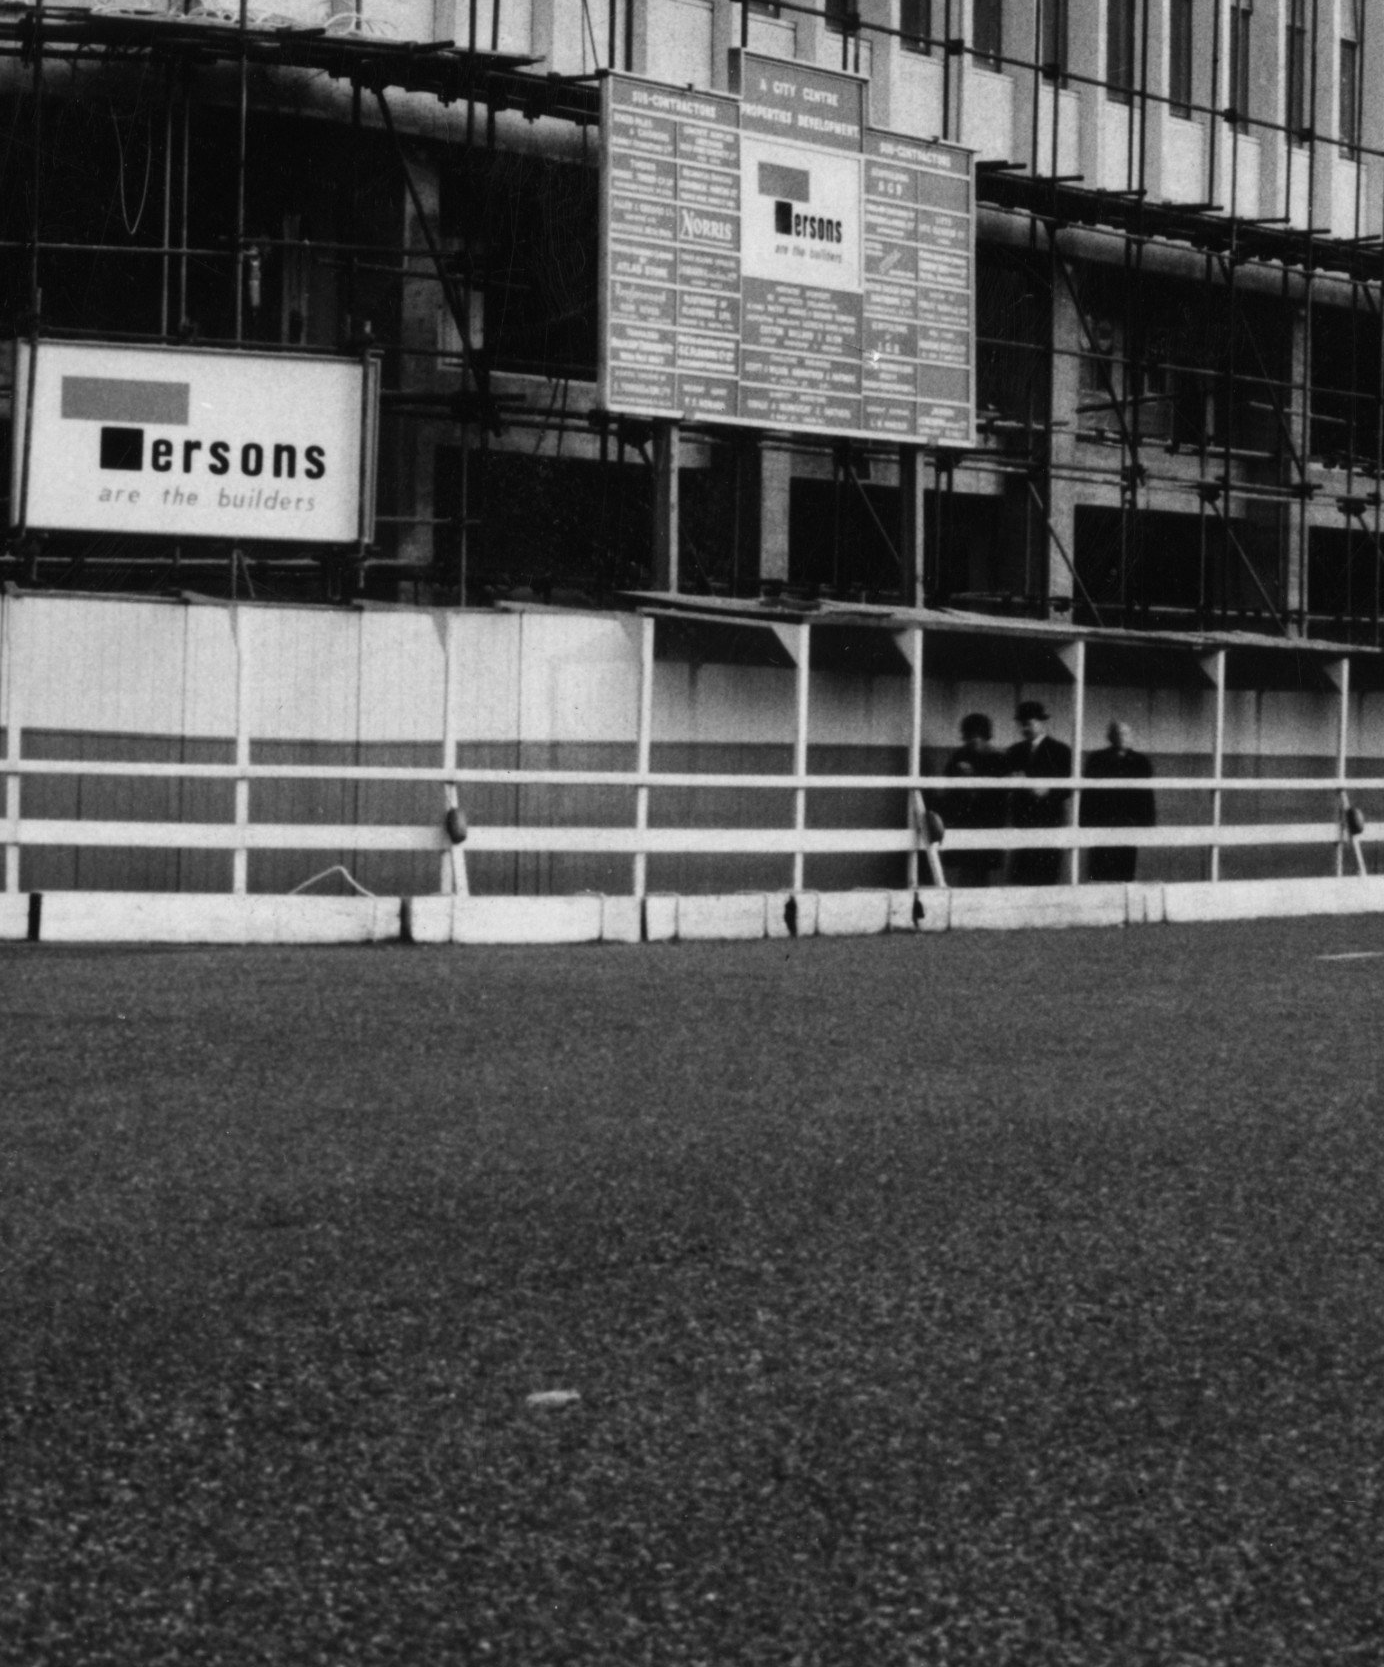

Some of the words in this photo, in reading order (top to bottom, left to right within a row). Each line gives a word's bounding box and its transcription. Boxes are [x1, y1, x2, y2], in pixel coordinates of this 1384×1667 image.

[98, 487, 141, 504] are
[162, 485, 199, 506] the
[218, 486, 316, 512] builders
